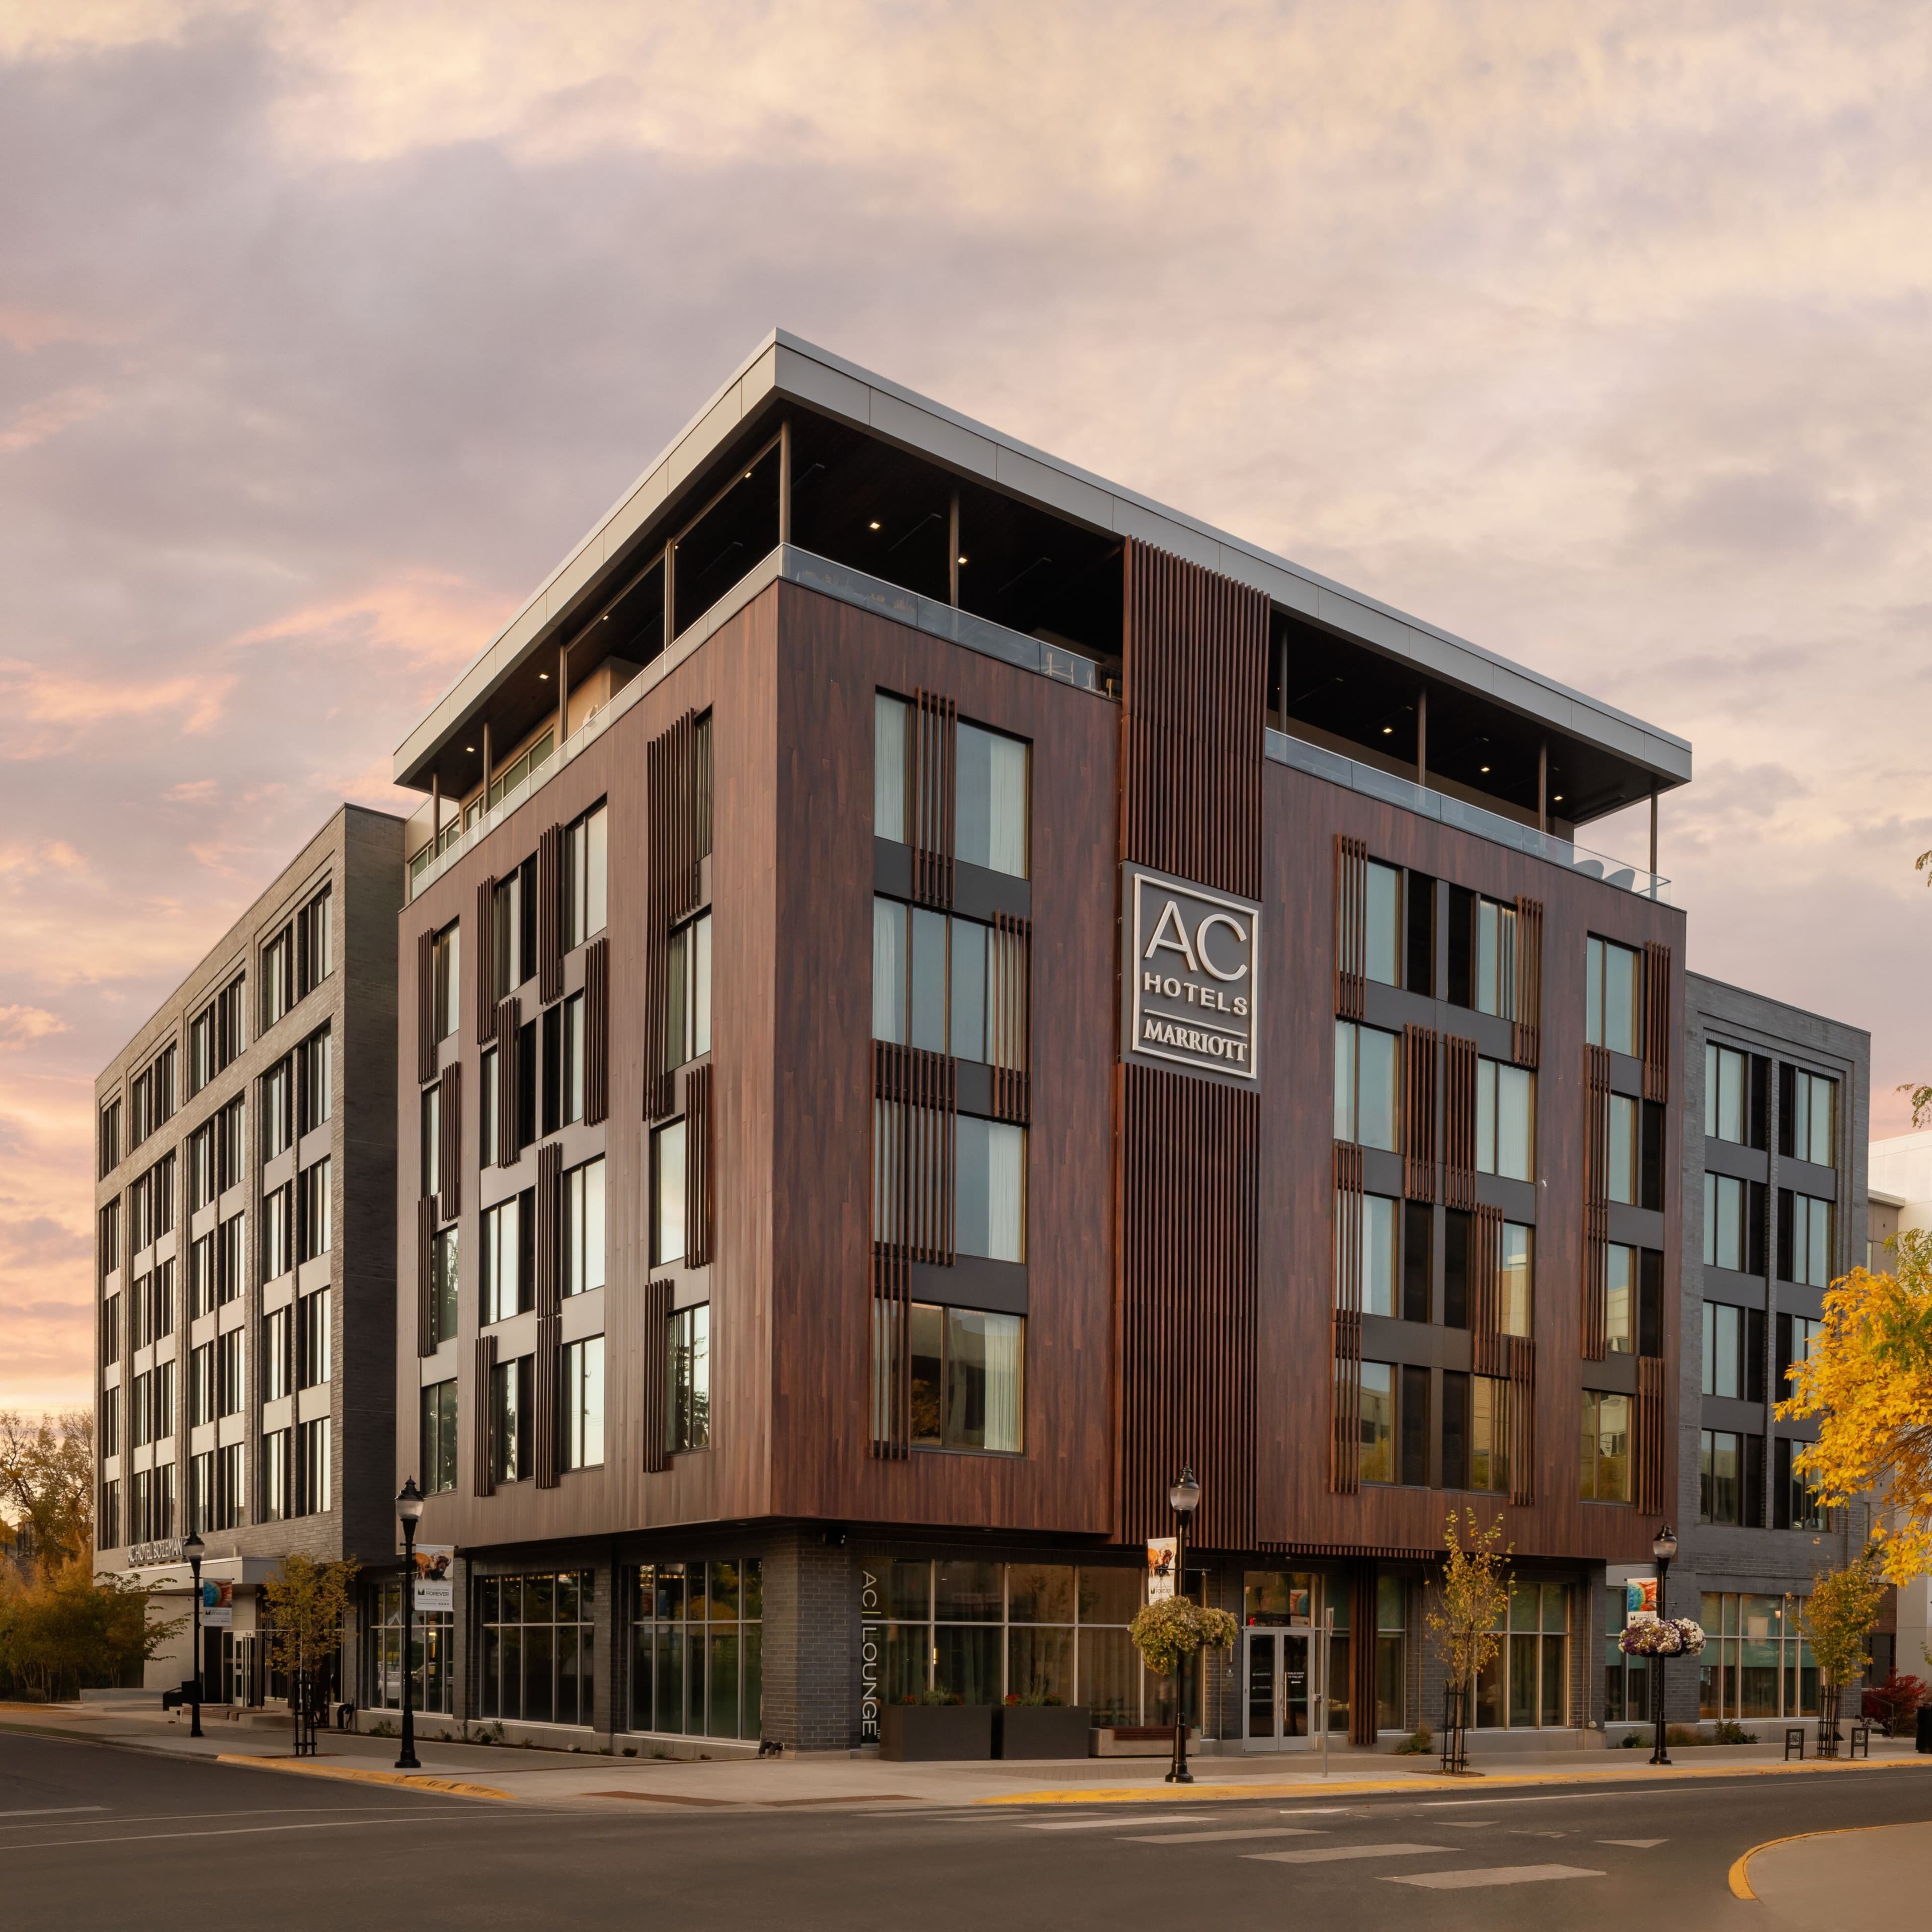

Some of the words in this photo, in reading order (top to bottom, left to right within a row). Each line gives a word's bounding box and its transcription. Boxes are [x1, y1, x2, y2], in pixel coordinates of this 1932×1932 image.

[1144, 900, 1248, 981] AC
[1144, 972, 1248, 1015] HOTELS
[1144, 1019, 1248, 1062] MARRIOTT
[135, 1543, 153, 1561] HOTEL
[153, 1538, 182, 1559] BOZEMAN
[862, 1570, 877, 1607] AC
[862, 1627, 877, 1736] LOUNGE
